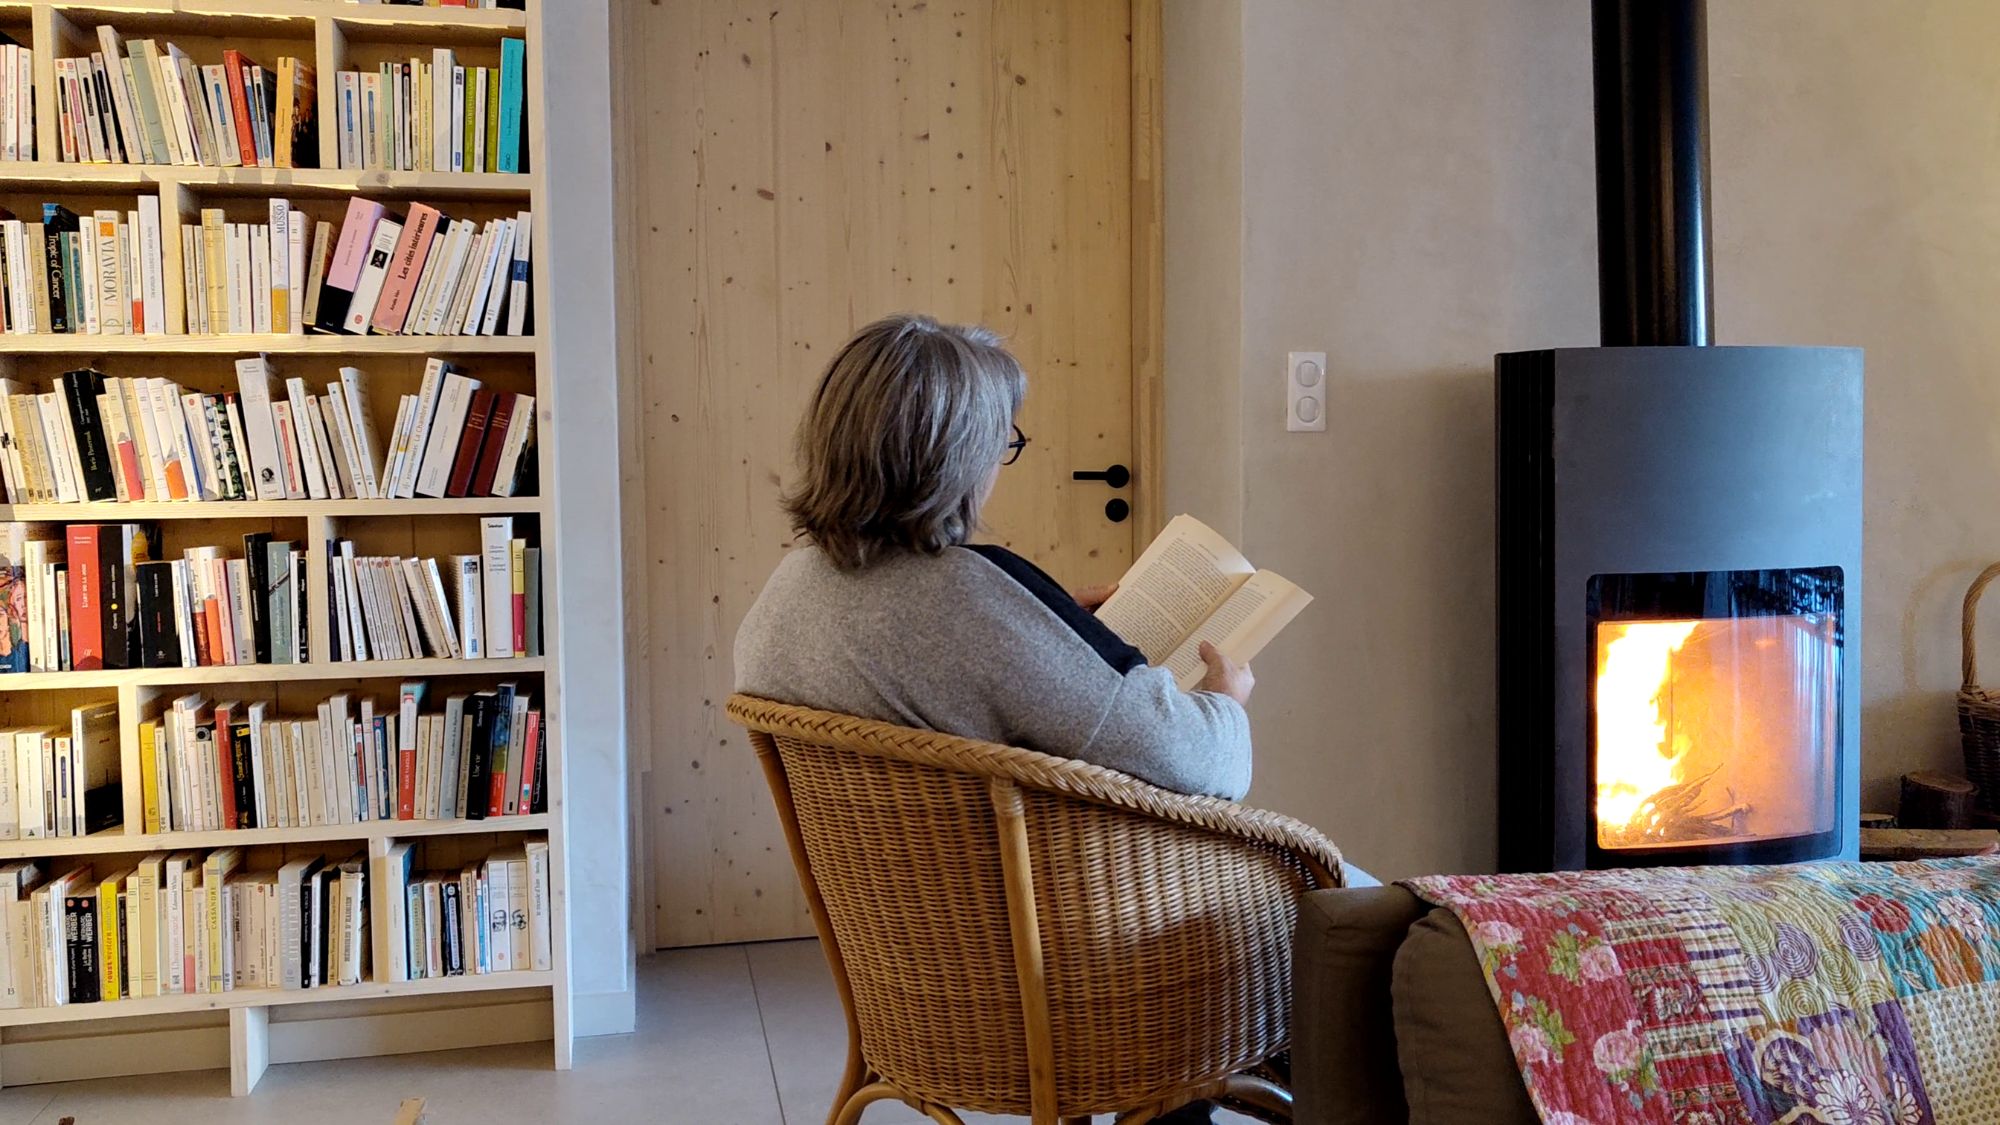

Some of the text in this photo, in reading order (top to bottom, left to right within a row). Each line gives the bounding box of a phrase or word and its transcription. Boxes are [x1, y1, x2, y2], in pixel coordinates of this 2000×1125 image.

[276, 204, 286, 234] MUSSO
[47, 233, 62, 299] Tropic of Cancer
[397, 212, 428, 280] Les cités intérieures
[103, 239, 118, 301] MORAVIA
[70, 912, 78, 942] WERBER
[85, 912, 93, 943] WERBER
